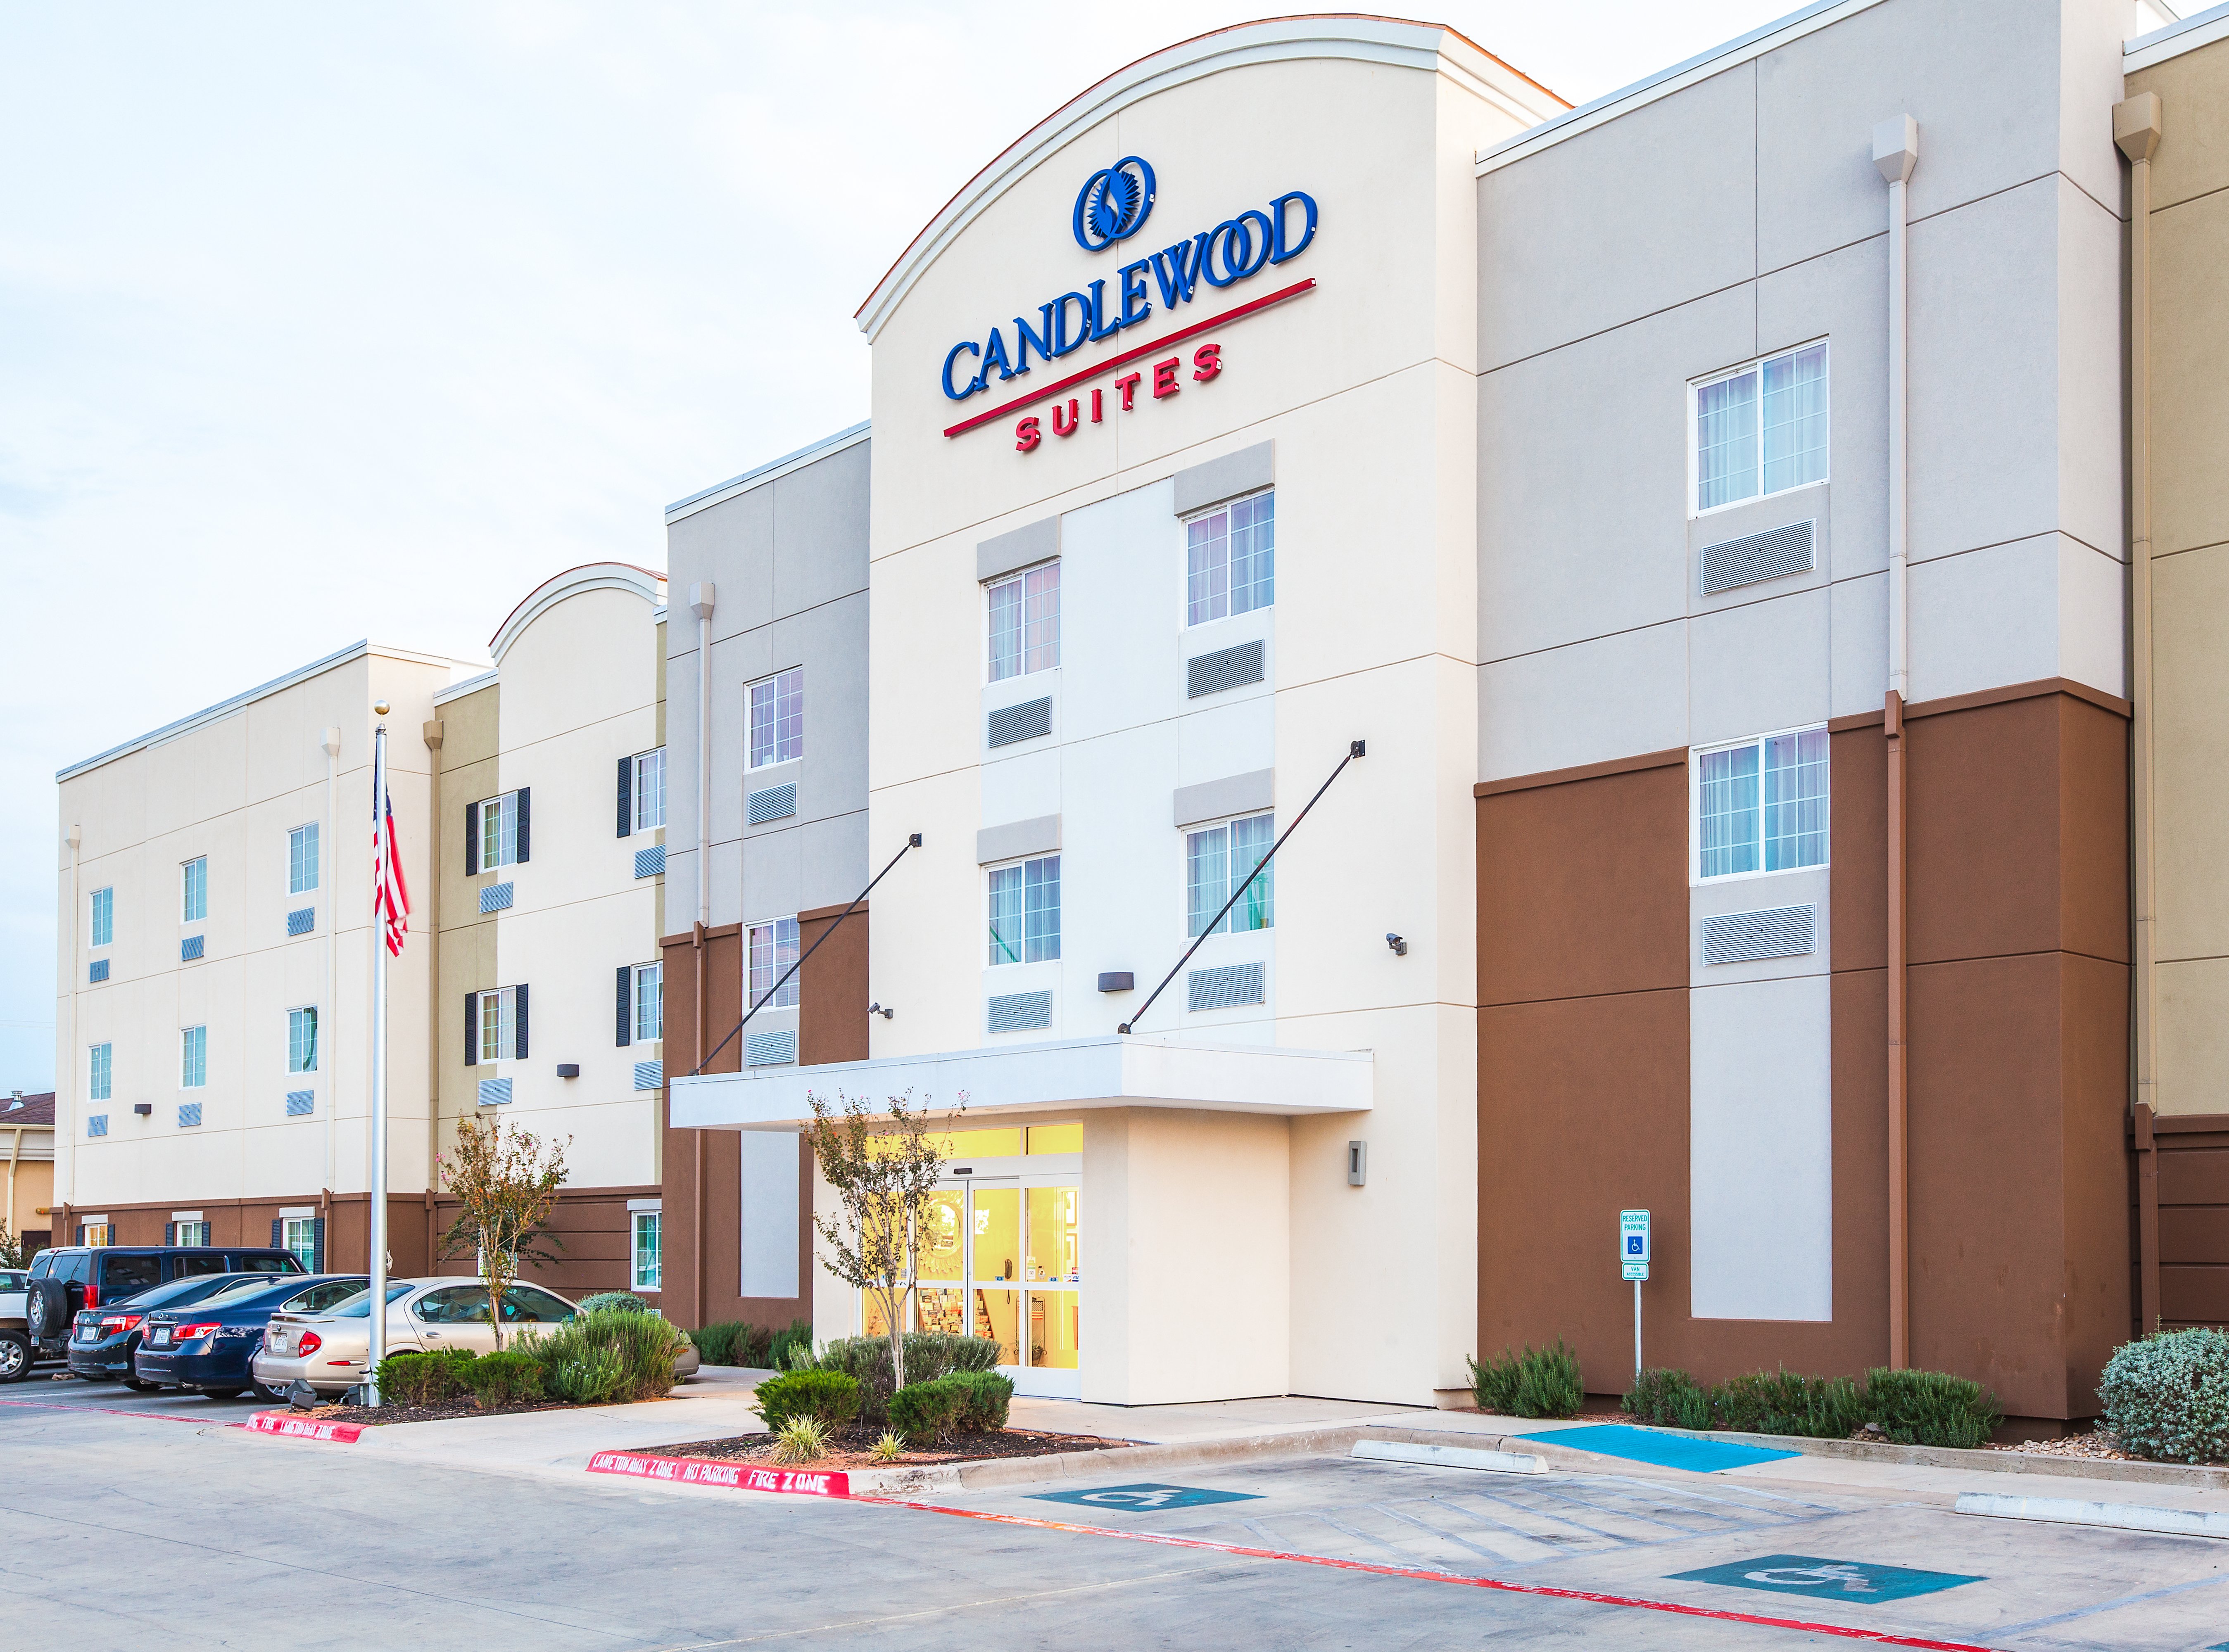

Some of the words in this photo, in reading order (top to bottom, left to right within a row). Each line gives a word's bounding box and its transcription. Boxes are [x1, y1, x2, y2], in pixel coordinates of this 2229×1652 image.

[942, 191, 1318, 401] CANDLEWOOD
[1015, 343, 1221, 452] SUITES
[315, 1425, 335, 1439] ZONE
[648, 1460, 677, 1478] ZONE
[683, 1463, 701, 1480] NO
[699, 1464, 741, 1484] PARKING
[748, 1469, 779, 1489] FIRE
[782, 1473, 830, 1493] ZONE
